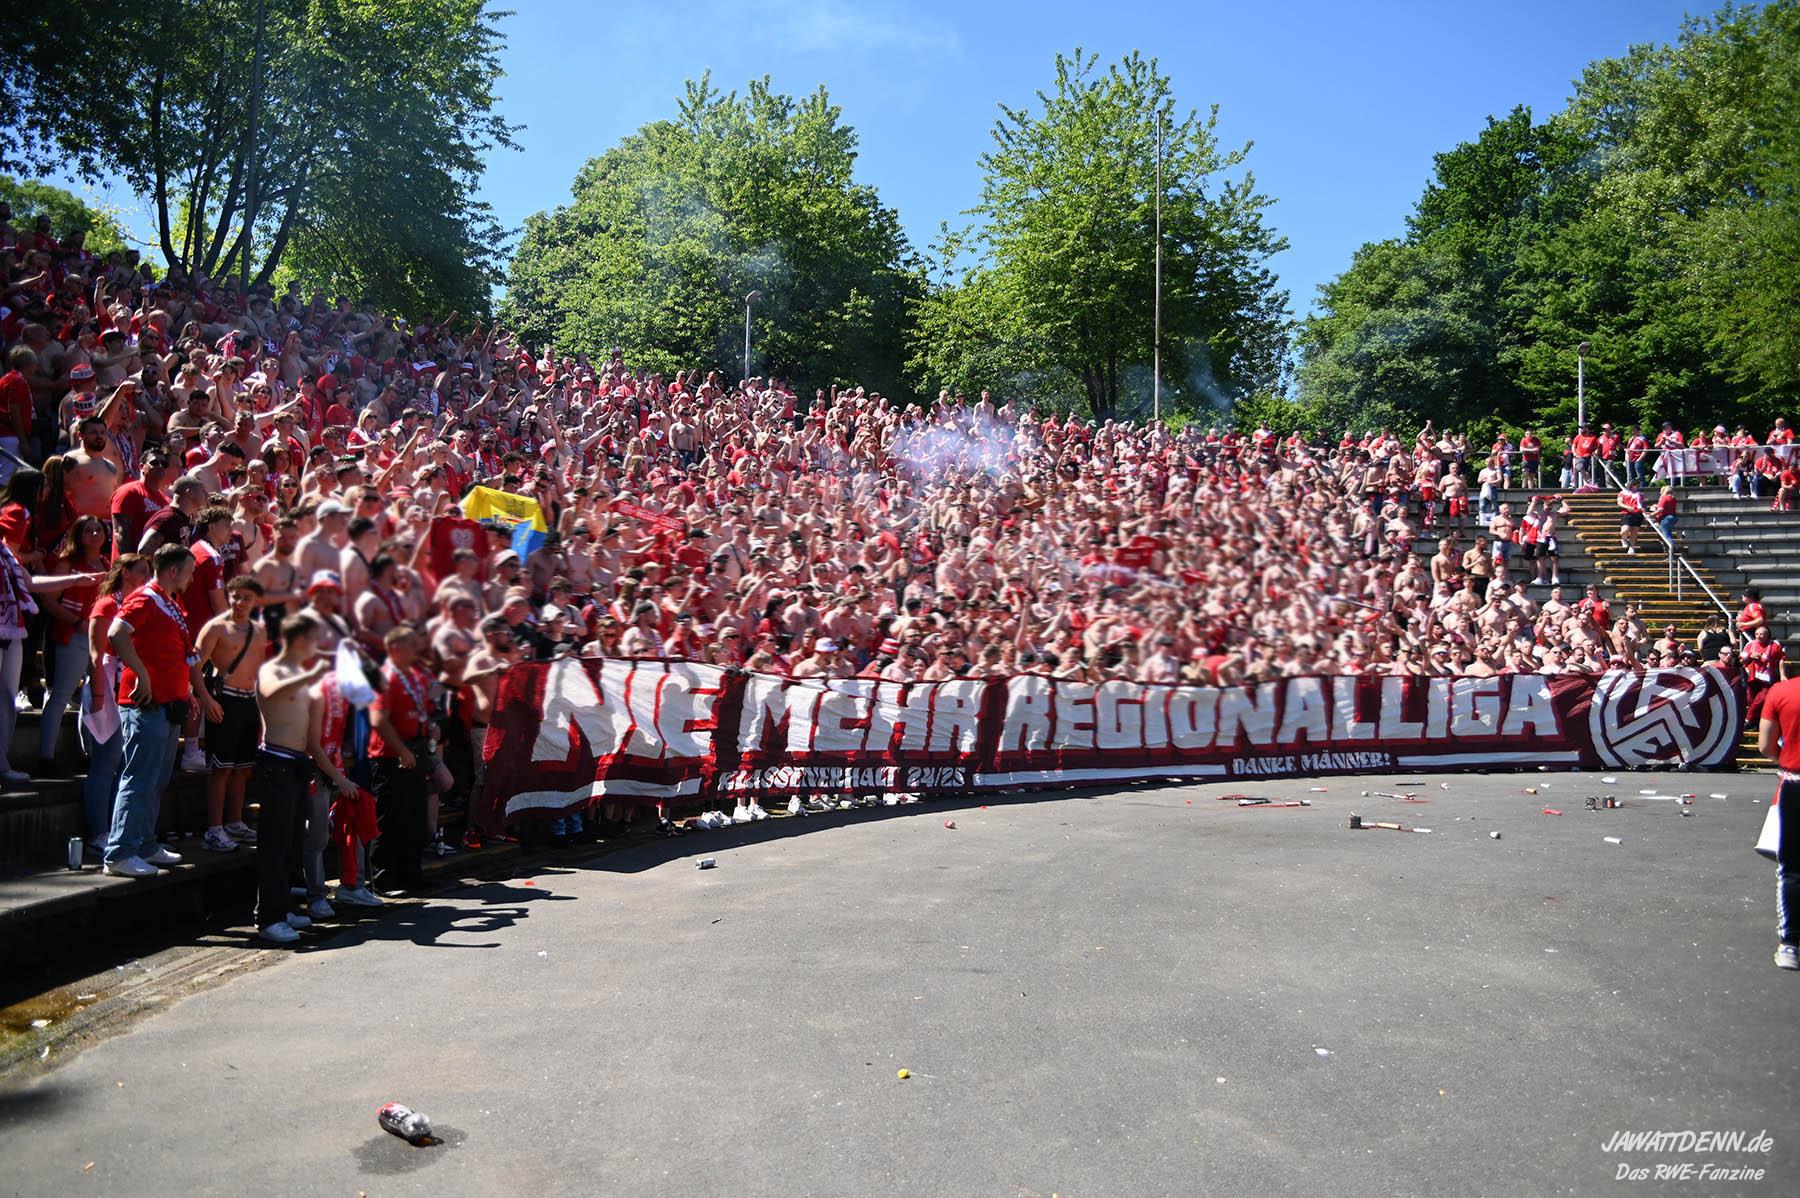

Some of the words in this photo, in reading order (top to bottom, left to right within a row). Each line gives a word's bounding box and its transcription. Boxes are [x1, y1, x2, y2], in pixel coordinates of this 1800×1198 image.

[531, 657, 725, 762] NIE
[738, 672, 983, 754] MEHR
[1232, 756, 1296, 774] DANKE
[1301, 750, 1391, 770] MÄNNER!
[718, 766, 897, 791] KLASSENERHALT
[907, 766, 966, 788] 24/25
